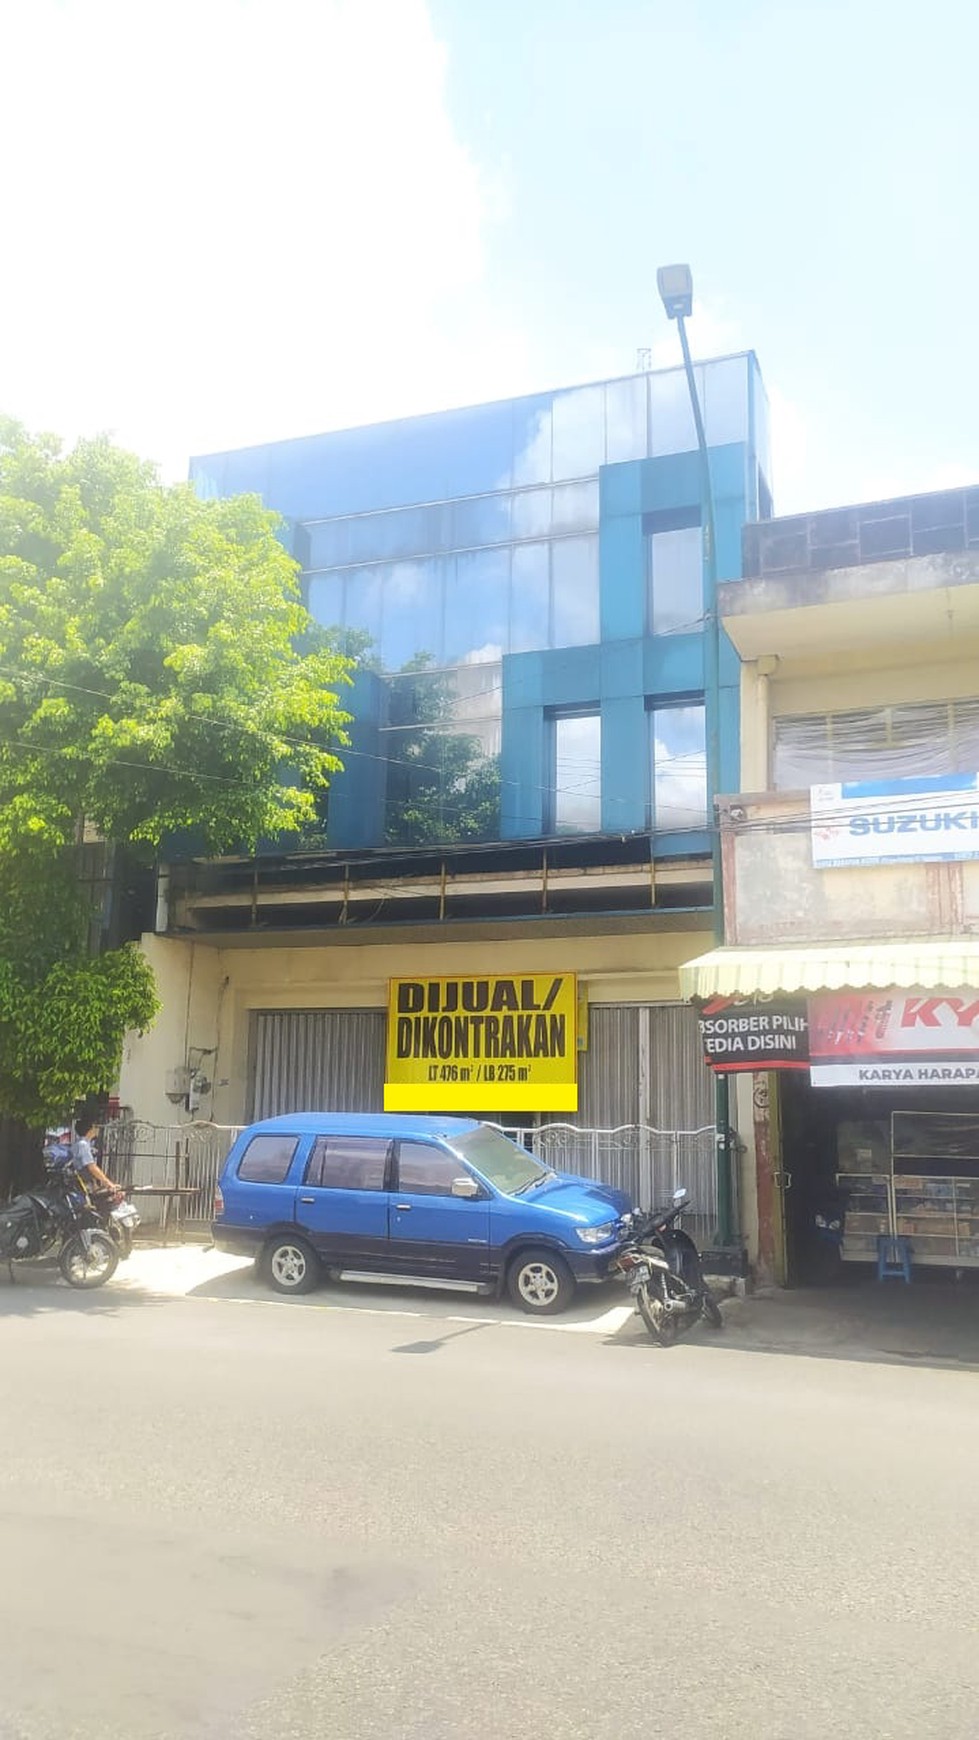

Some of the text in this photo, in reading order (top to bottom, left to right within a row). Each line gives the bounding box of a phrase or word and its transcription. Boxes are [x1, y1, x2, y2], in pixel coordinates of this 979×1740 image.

[849, 811, 978, 836] SUZUKI
[397, 978, 563, 1013] DIJUAL/
[397, 1014, 565, 1059] DIKONTRAKAN
[704, 1034, 796, 1053] EDIA DISINI
[429, 1065, 438, 1081] LT
[440, 1064, 458, 1081] 476
[476, 1064, 481, 1082] /
[484, 1064, 495, 1081] LB
[498, 1064, 515, 1081] 275
[859, 1068, 914, 1081] KARYA
